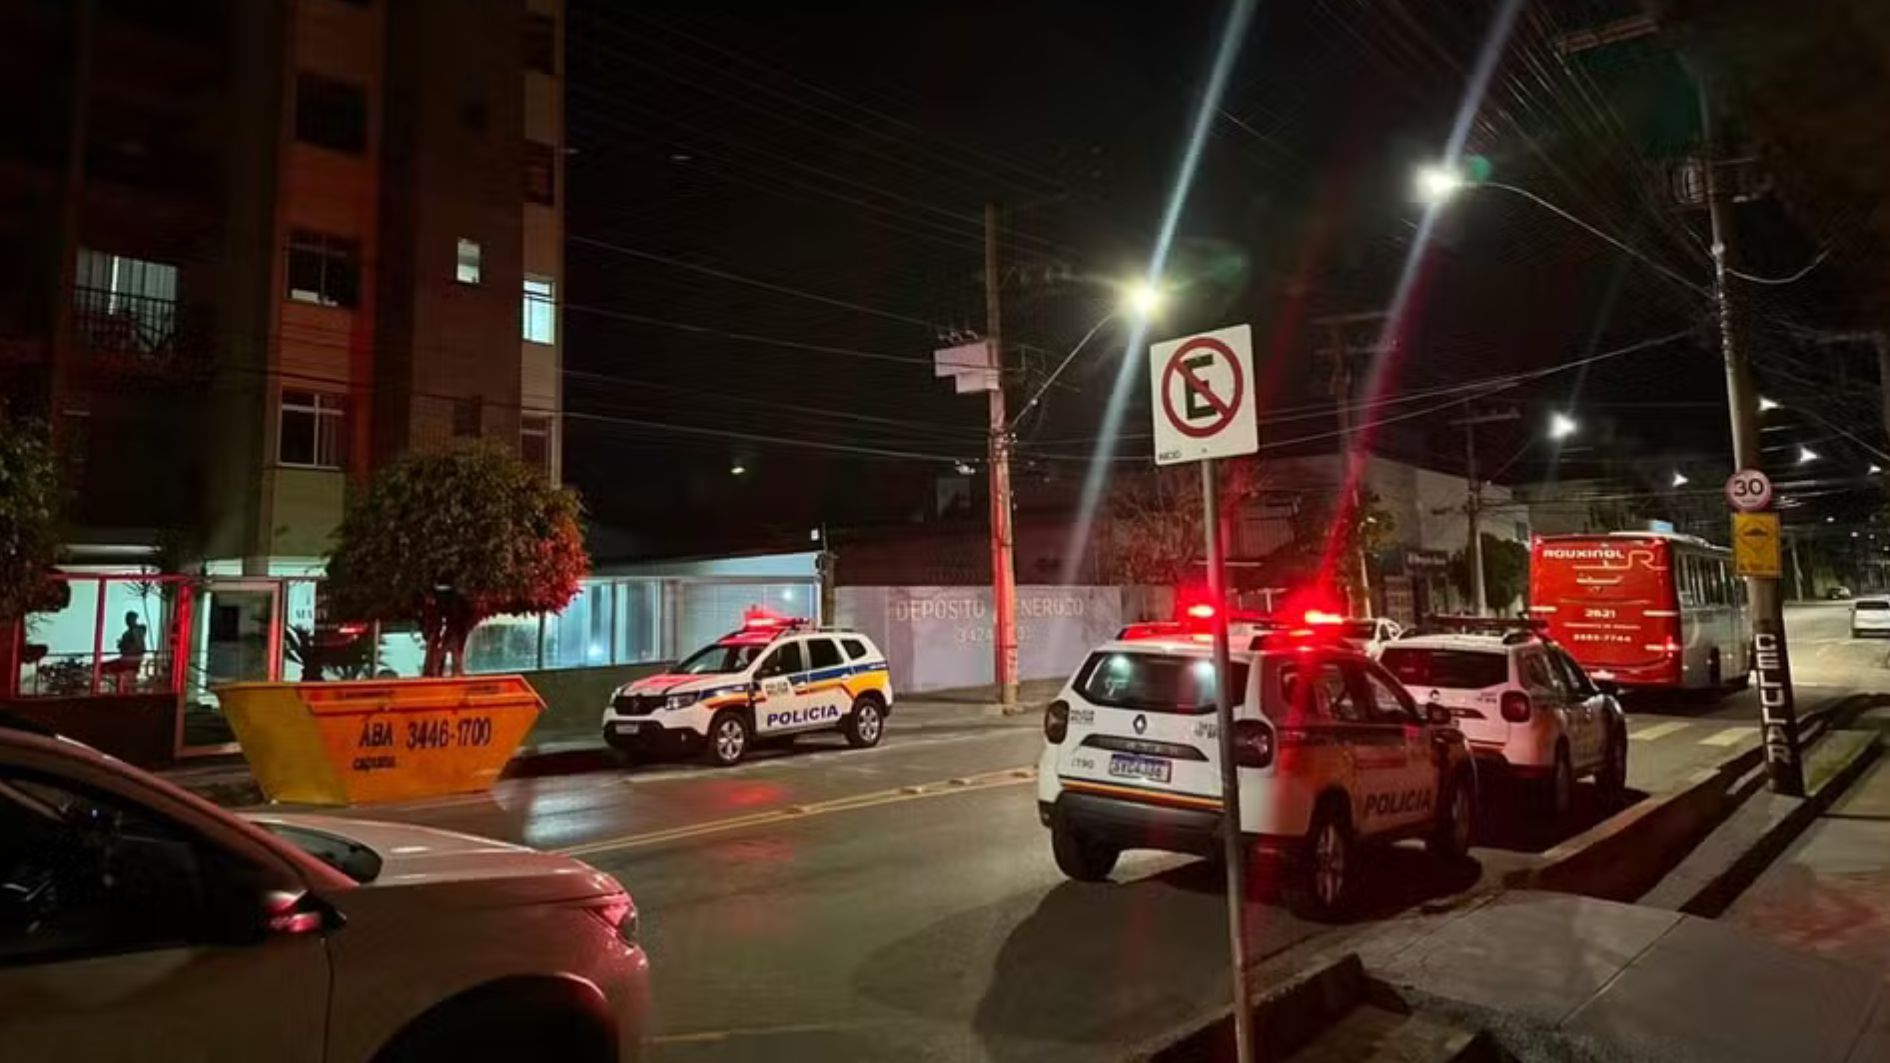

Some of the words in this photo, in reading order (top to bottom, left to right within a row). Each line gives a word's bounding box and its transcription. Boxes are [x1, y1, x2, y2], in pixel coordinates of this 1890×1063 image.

[1183, 353, 1218, 421] E
[1734, 478, 1764, 497] 30
[359, 722, 394, 747] ABA
[406, 717, 492, 750] 3446-1700
